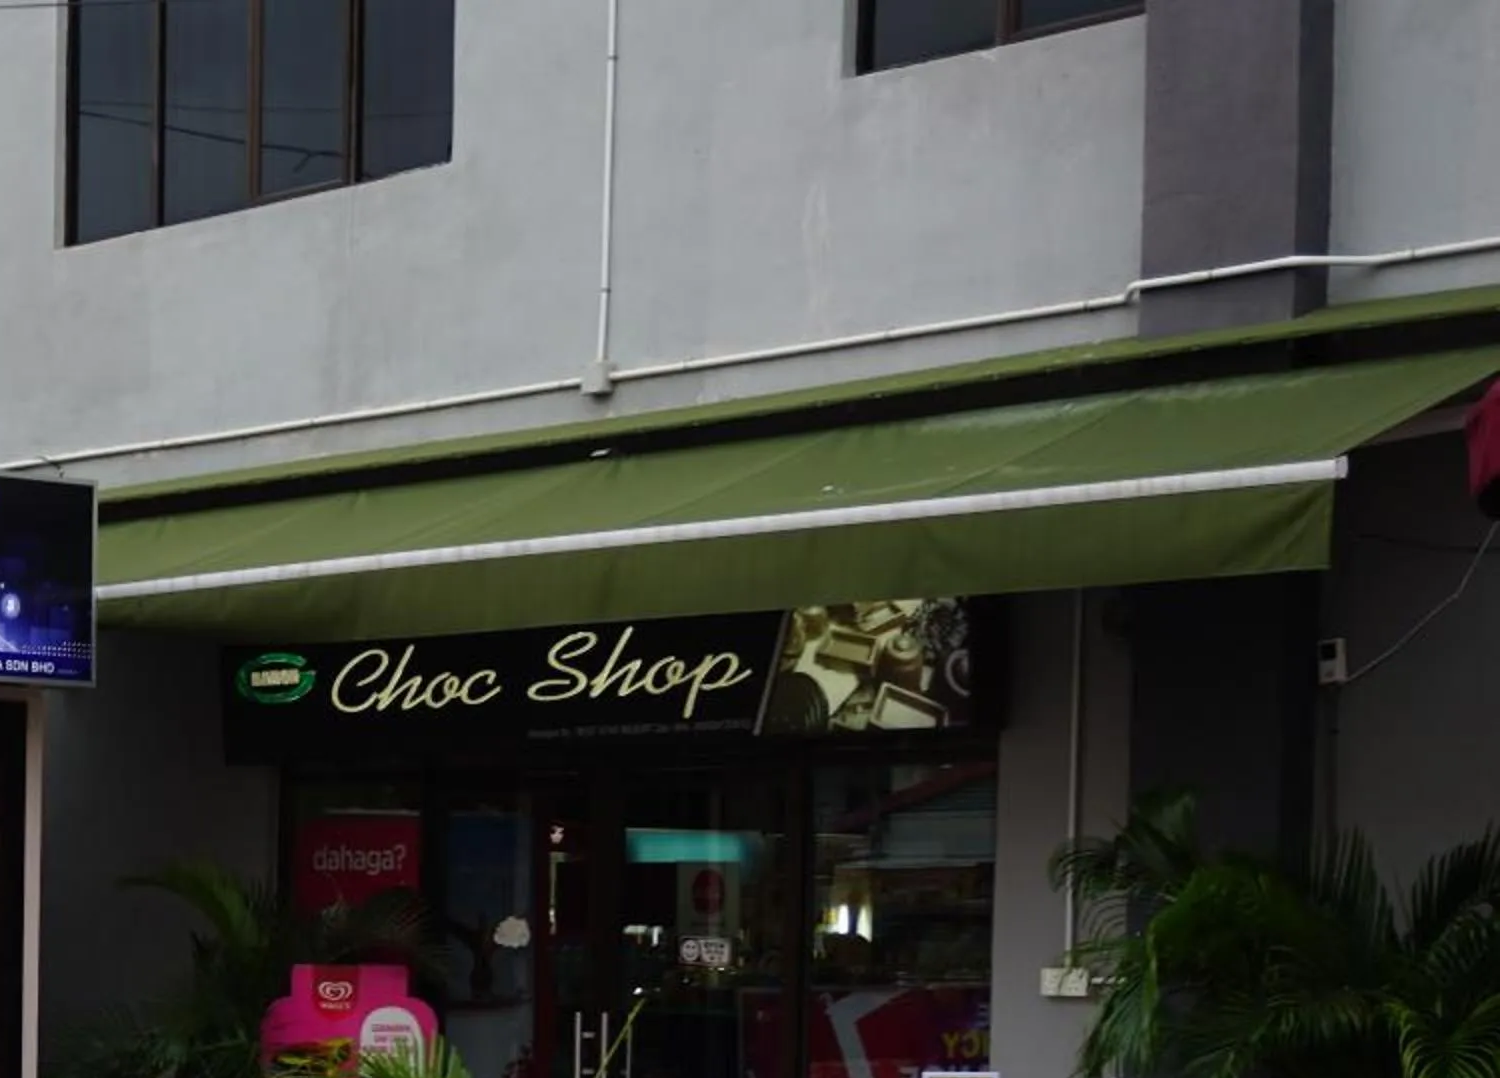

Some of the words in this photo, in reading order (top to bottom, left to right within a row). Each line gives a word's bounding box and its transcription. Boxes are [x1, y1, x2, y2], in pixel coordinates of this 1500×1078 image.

[6, 658, 29, 673] SDN
[32, 660, 56, 674] BHD
[331, 644, 502, 714] Choc
[526, 625, 752, 719] Shop
[312, 844, 407, 876] dahaga?
